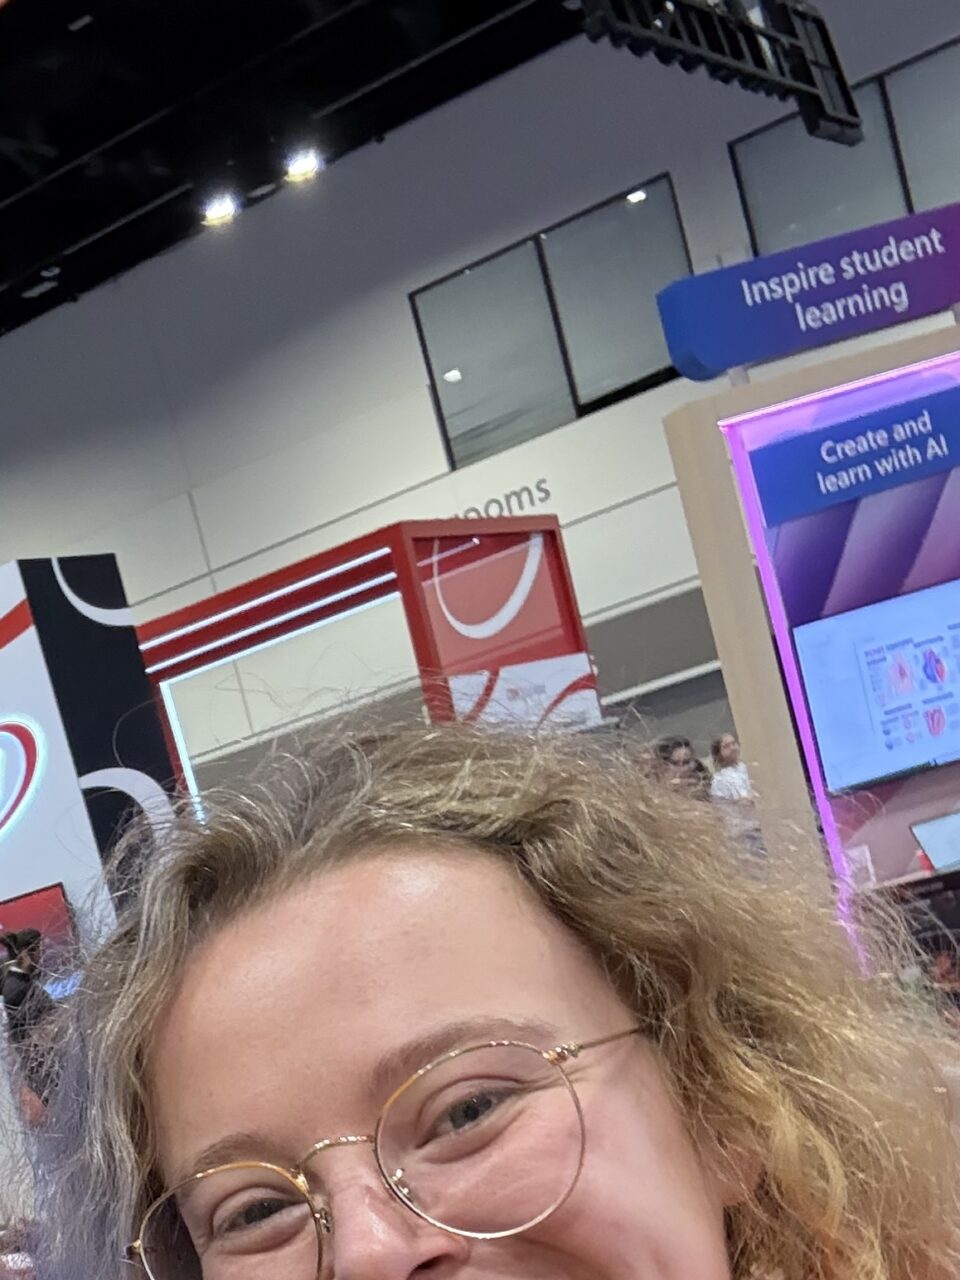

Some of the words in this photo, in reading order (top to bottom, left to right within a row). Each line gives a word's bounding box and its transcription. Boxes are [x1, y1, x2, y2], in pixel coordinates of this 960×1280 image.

[741, 261, 836, 307] Inspire
[840, 227, 946, 281] student
[795, 281, 909, 332] learning
[820, 428, 889, 464] Create
[892, 408, 932, 442] and
[816, 463, 872, 495] learn
[874, 443, 922, 477] with
